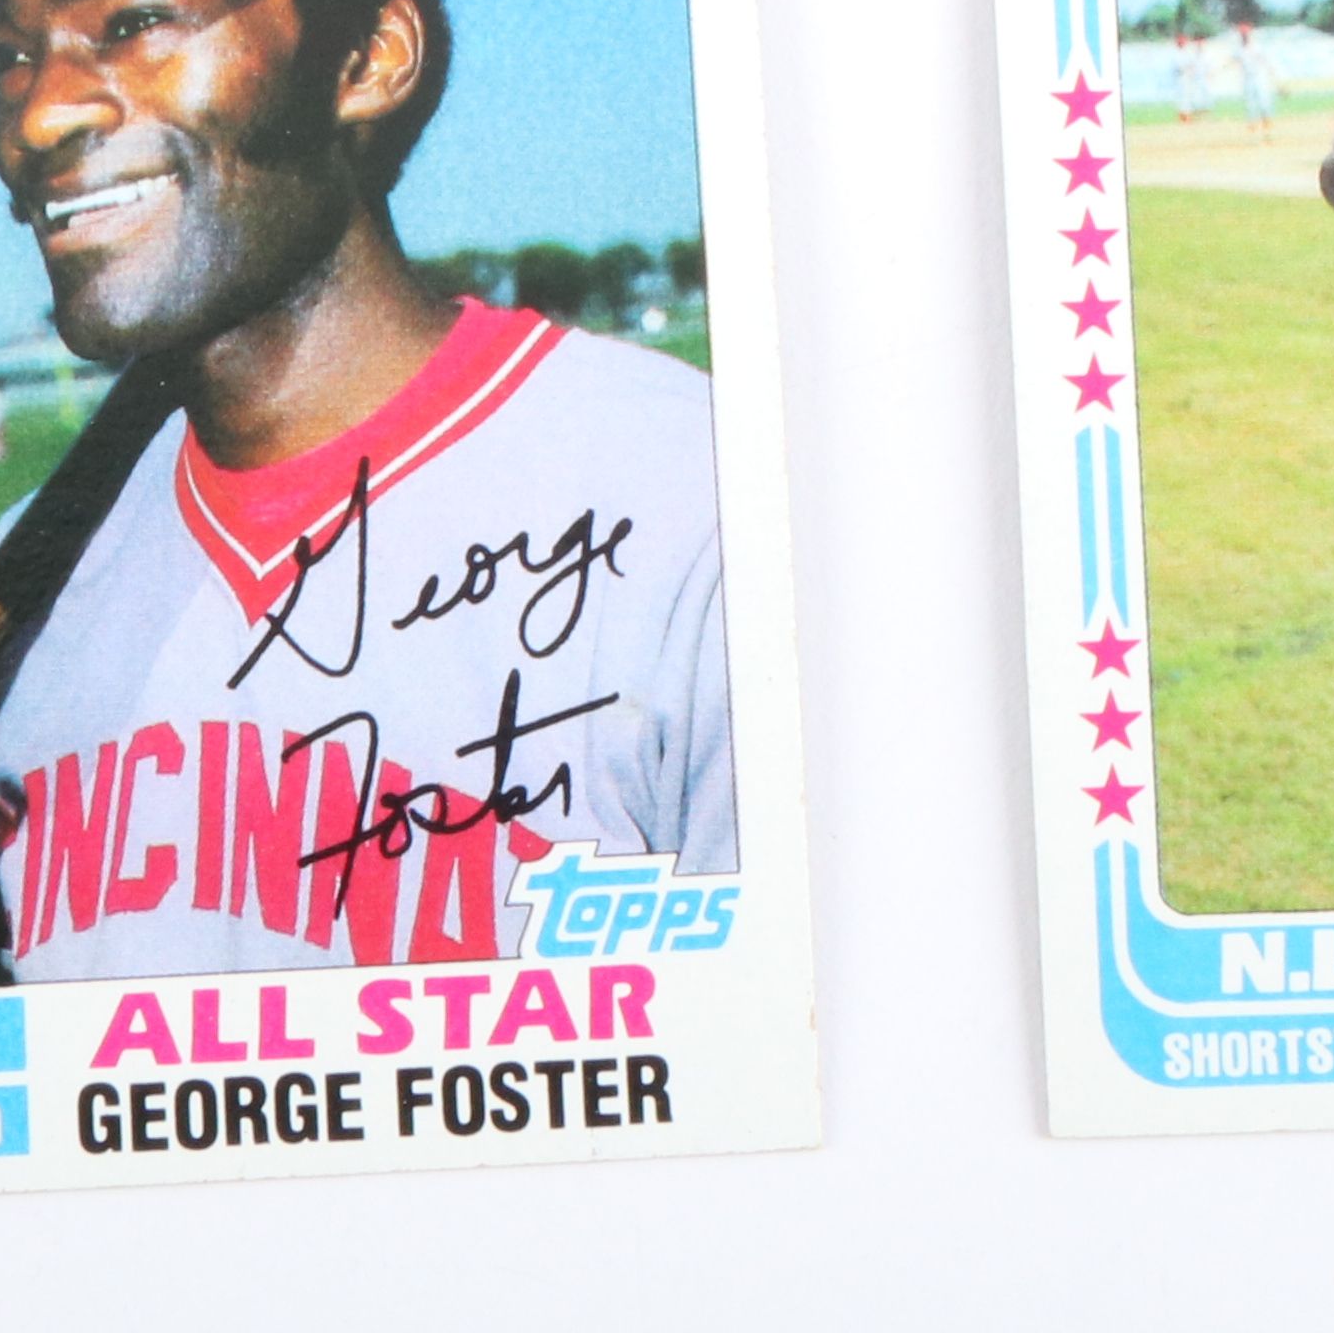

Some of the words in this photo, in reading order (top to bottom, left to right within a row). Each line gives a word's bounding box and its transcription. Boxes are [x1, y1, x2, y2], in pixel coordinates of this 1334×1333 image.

[227, 455, 633, 690] George
[282, 669, 619, 921] Foster
[526, 856, 740, 959] topps
[88, 982, 316, 1070] ALL
[355, 963, 658, 1054] STAR
[76, 1069, 365, 1156] GEORGE
[397, 1054, 674, 1140] FOSTER
